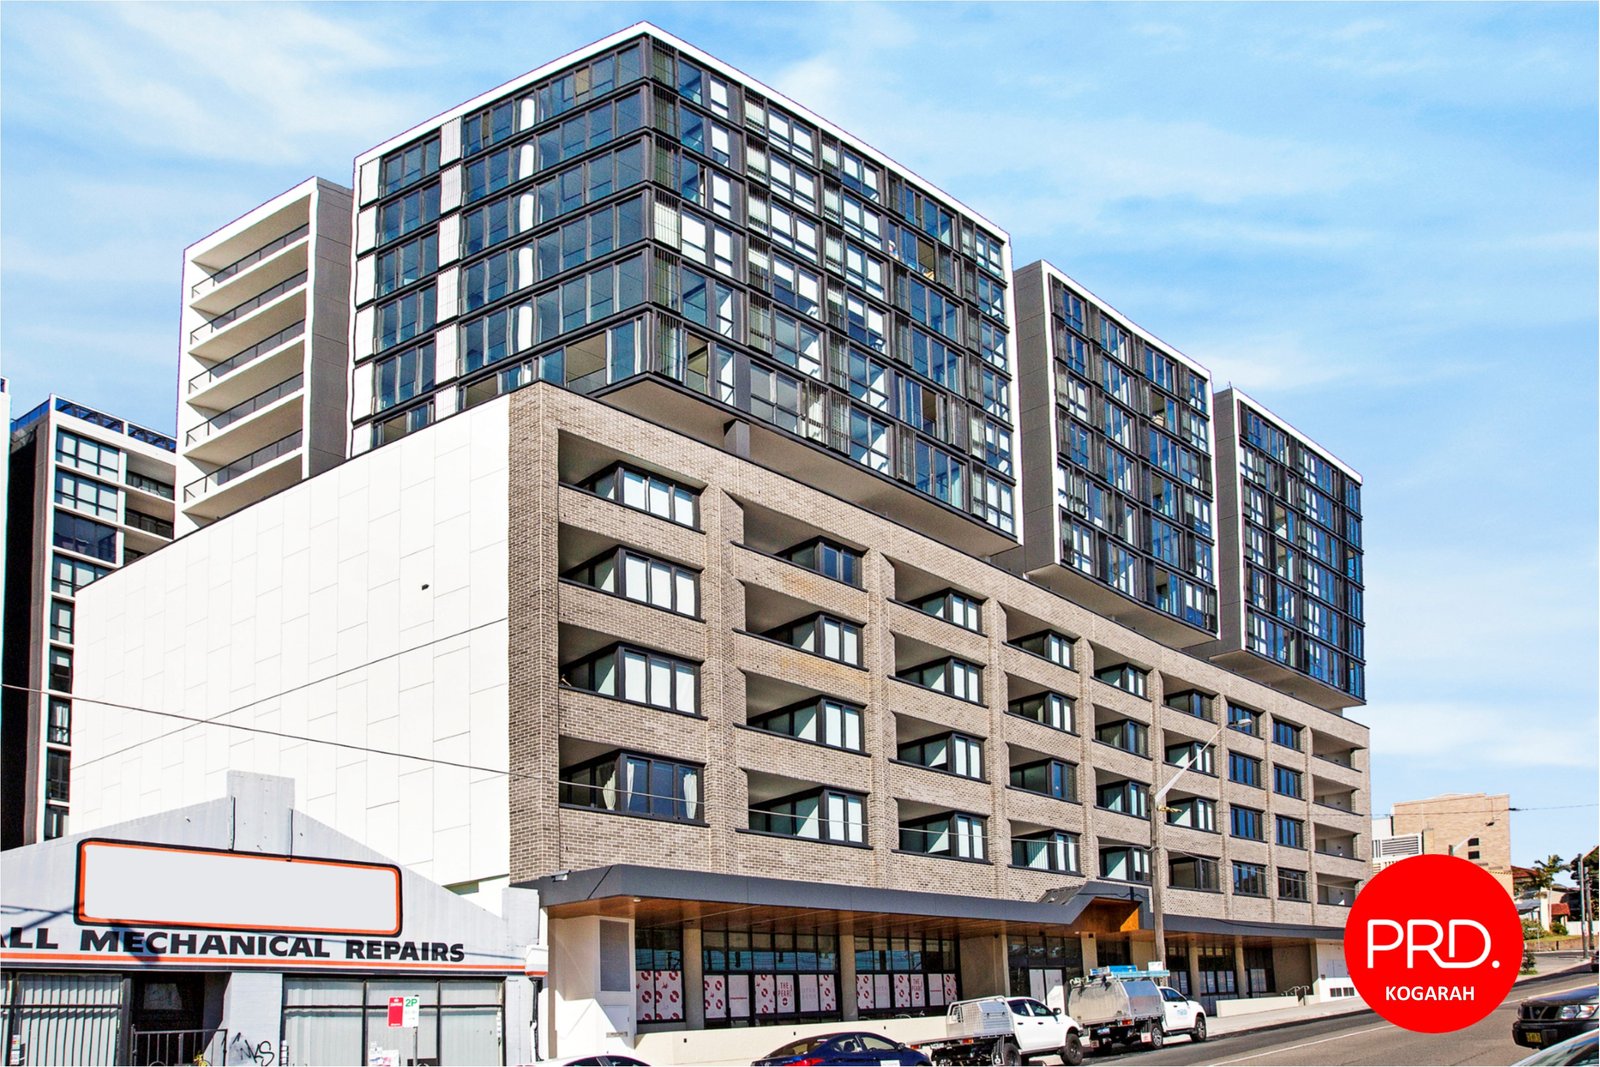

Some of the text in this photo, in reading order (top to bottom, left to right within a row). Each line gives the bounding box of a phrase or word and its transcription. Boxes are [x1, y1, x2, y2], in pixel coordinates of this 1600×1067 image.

[0, 927, 465, 963] LL MECHANICAL REPAIRS
[405, 998, 418, 1008] 2P
